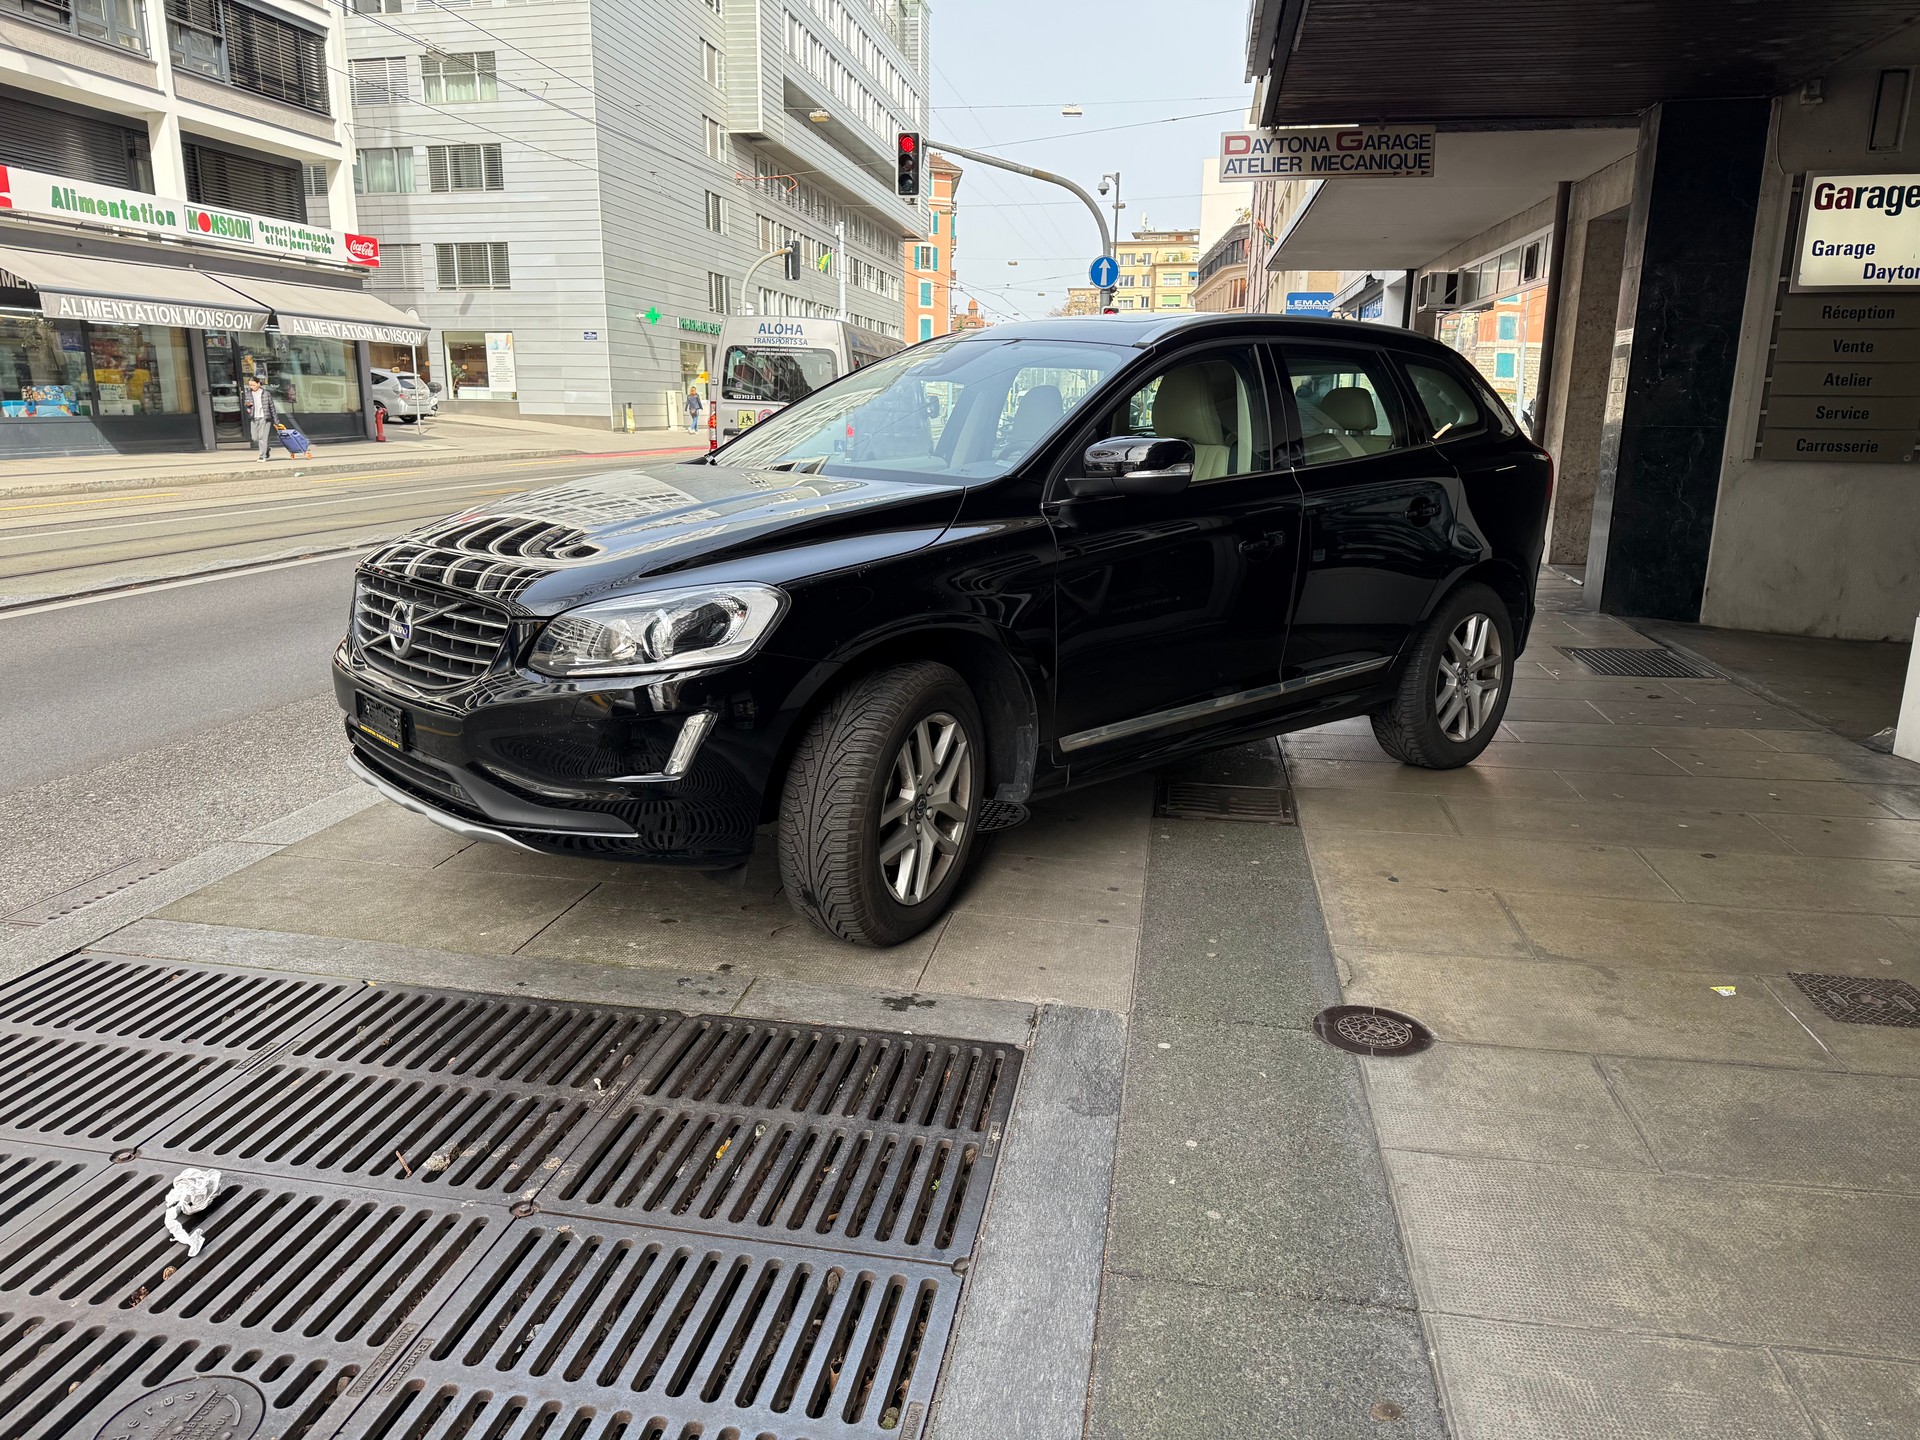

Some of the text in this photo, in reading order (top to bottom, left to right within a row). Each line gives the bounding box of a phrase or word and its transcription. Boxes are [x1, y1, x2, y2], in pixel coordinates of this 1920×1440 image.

[1224, 131, 1432, 155] DAYTONA GARAGE
[1224, 152, 1431, 175] ATELIER MECANIQUE
[51, 185, 177, 226] Alimentation
[1814, 182, 1920, 217] Garage
[187, 209, 252, 240] MONSOON
[258, 220, 335, 245] Ouvert le dimanche
[265, 234, 274, 245] et
[275, 234, 288, 248] les
[289, 238, 310, 251] jours
[1812, 240, 1876, 259] Garage
[59, 297, 253, 330] ALIMENTATION MONSOON
[1821, 305, 1895, 322] Réception
[293, 319, 421, 345] ALIMENTATION MONSOON
[758, 323, 803, 336] ALOHA
[753, 337, 808, 346] TRANSPORTS SA
[1833, 339, 1874, 353] Vente
[1823, 372, 1873, 387] Atelier
[1815, 405, 1869, 420] Service
[1796, 438, 1878, 453] Carrosserie
